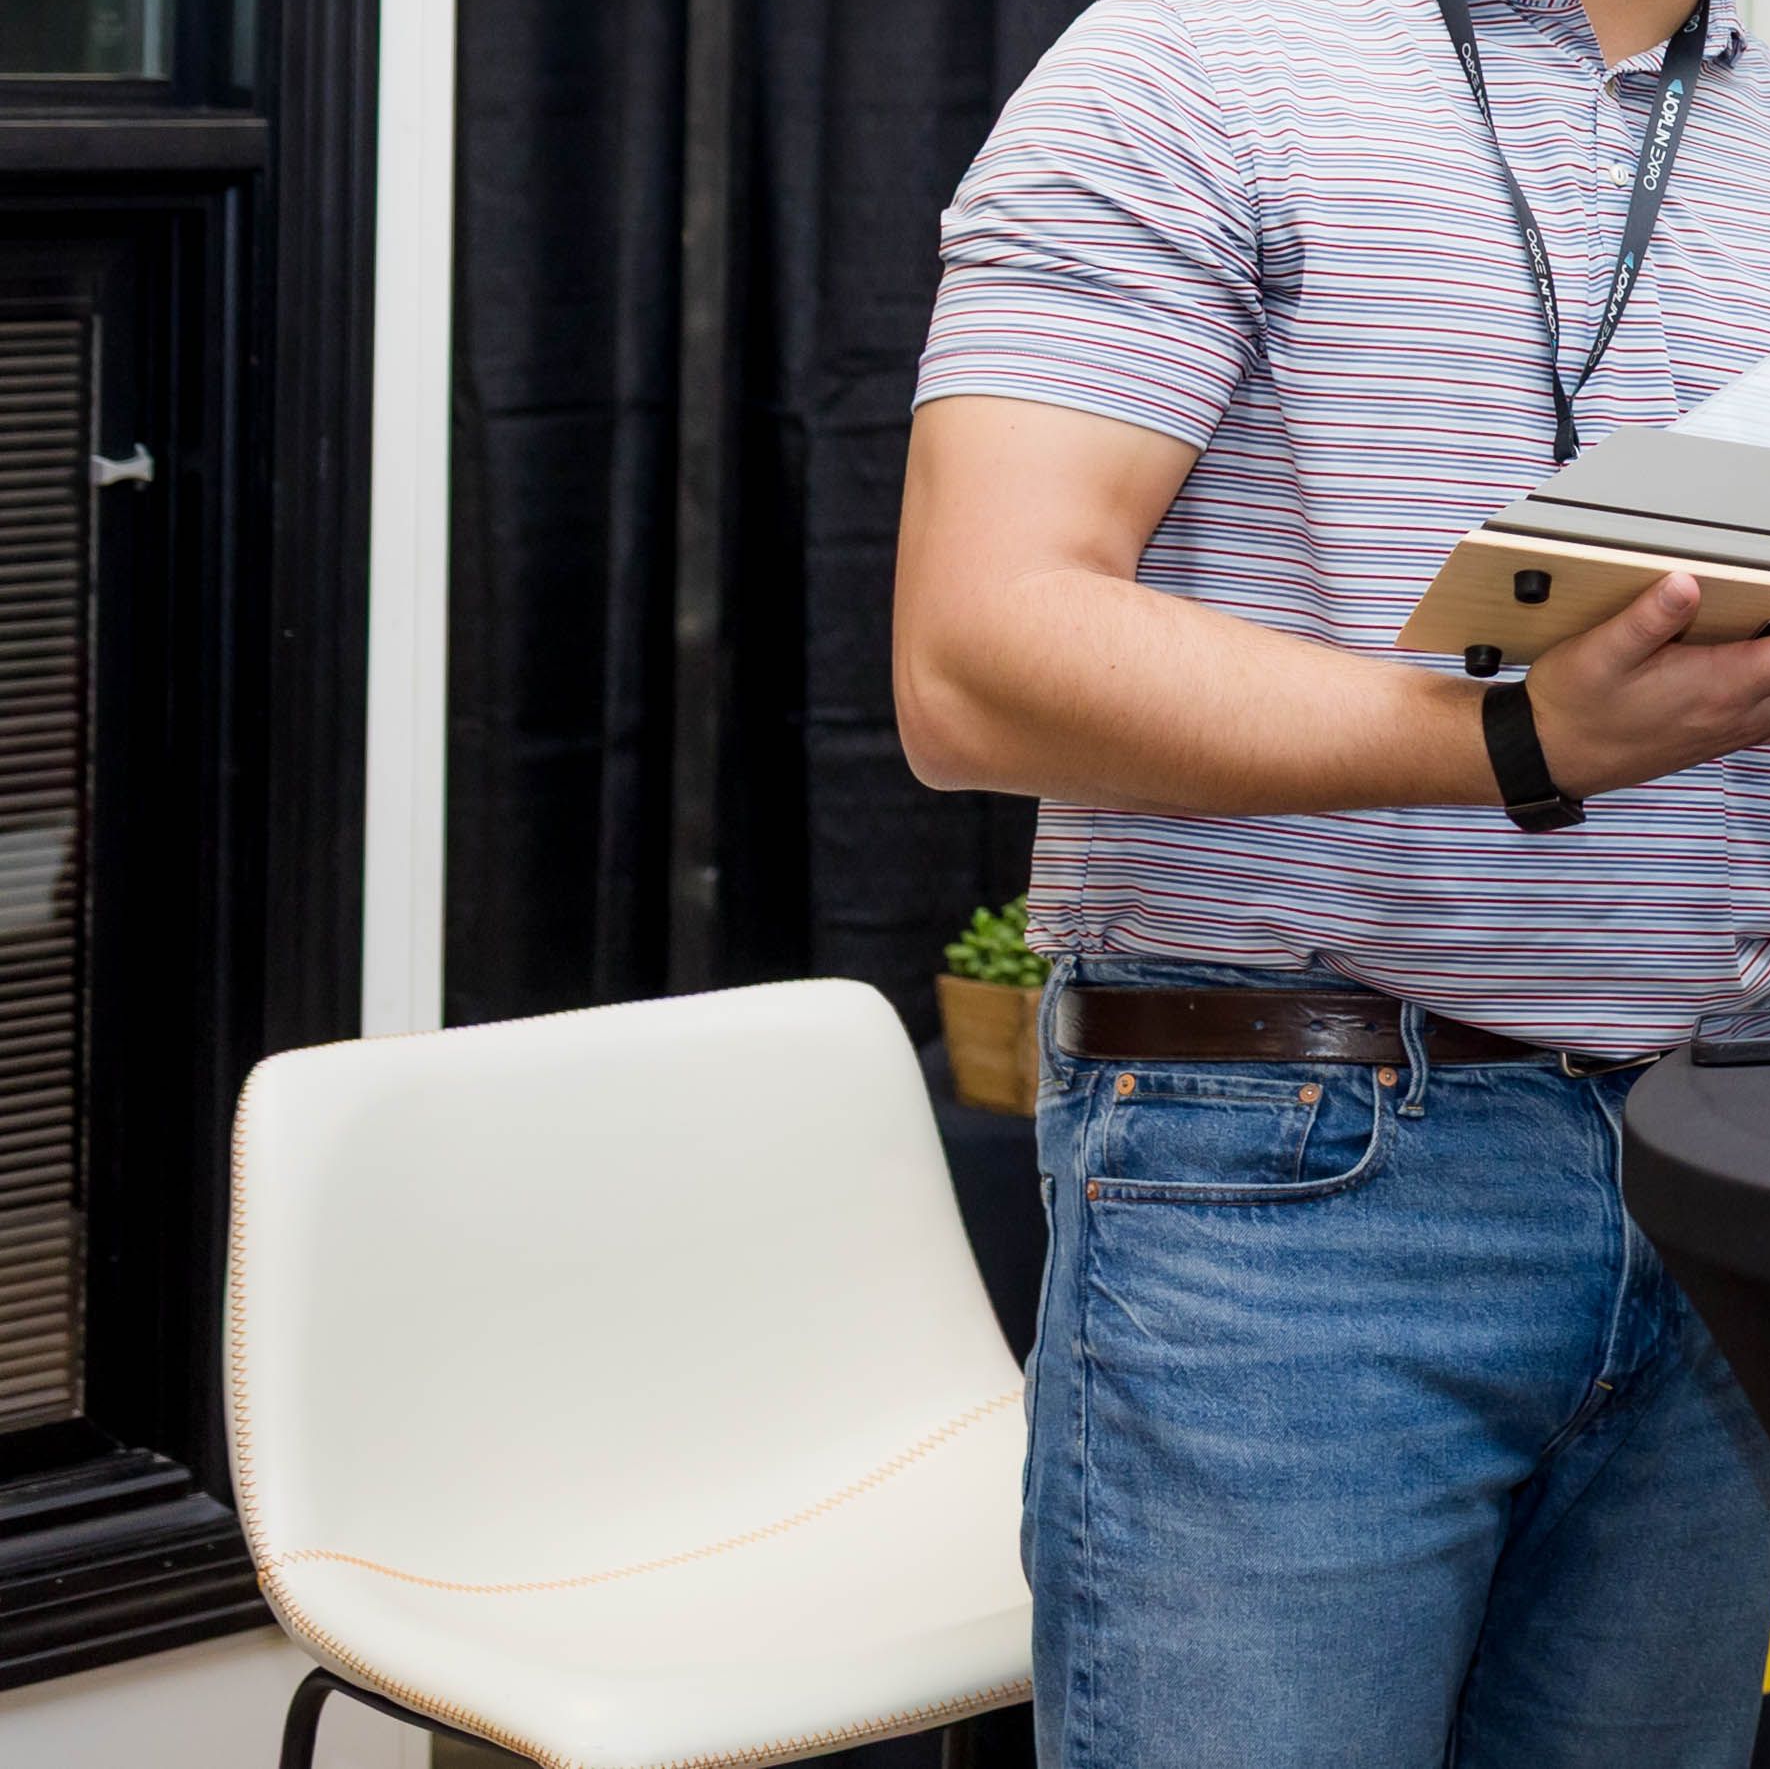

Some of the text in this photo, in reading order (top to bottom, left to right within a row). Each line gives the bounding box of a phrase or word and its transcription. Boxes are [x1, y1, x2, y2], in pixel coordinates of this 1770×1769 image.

[1643, 91, 1681, 191] JOPLIN EXPO
[1526, 228, 1558, 340] JOPLIN EXPO
[1607, 264, 1630, 323] JOPLIN
